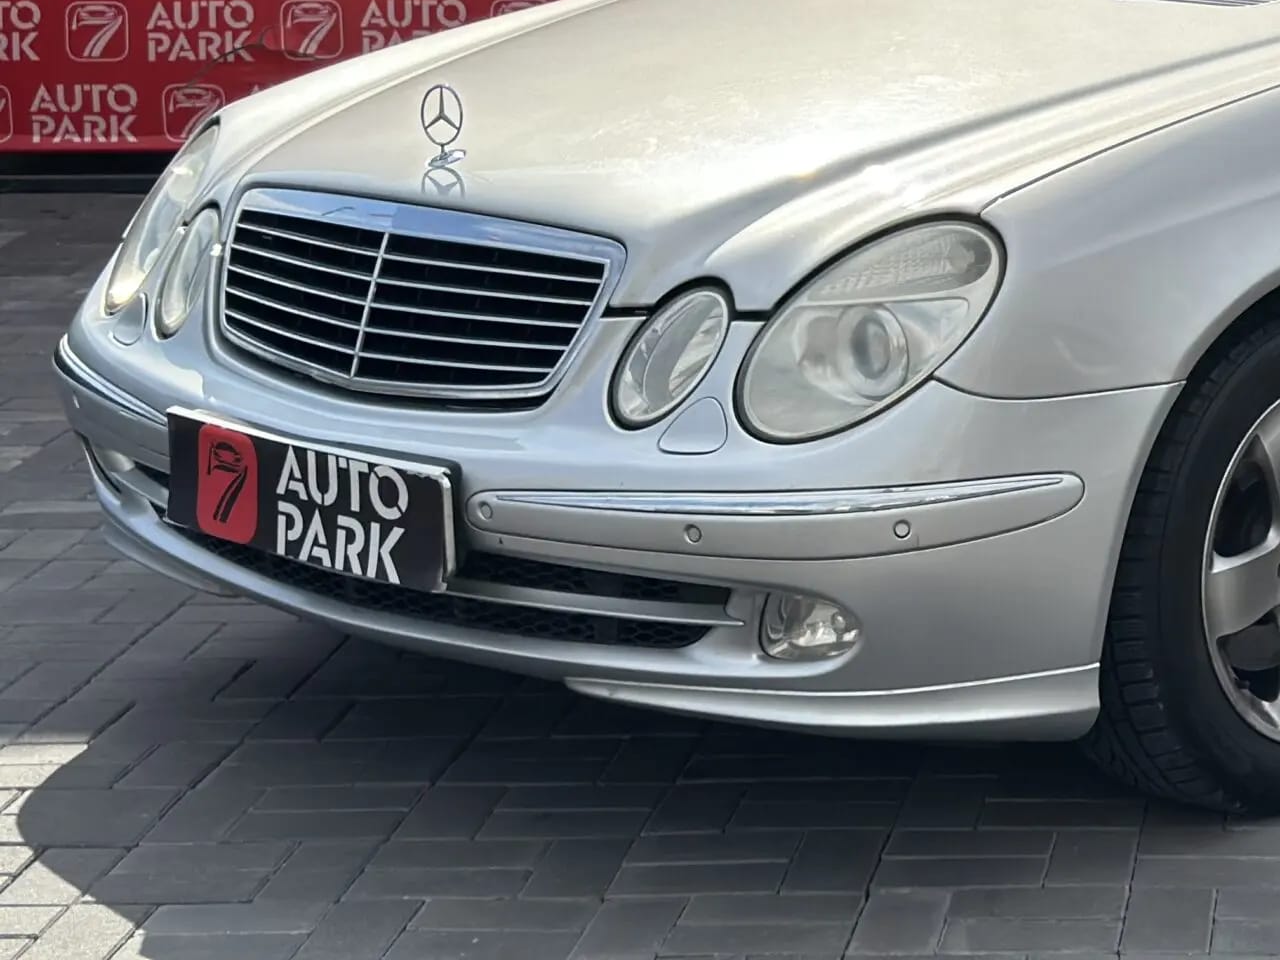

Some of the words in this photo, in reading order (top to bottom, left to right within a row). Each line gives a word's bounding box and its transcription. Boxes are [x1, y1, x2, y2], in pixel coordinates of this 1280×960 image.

[146, 0, 254, 30] AUTO
[148, 30, 254, 62] PARK
[30, 83, 138, 113] AUTO
[32, 114, 138, 144] PARK
[276, 445, 409, 520] AUTO
[276, 501, 405, 585] PARK
